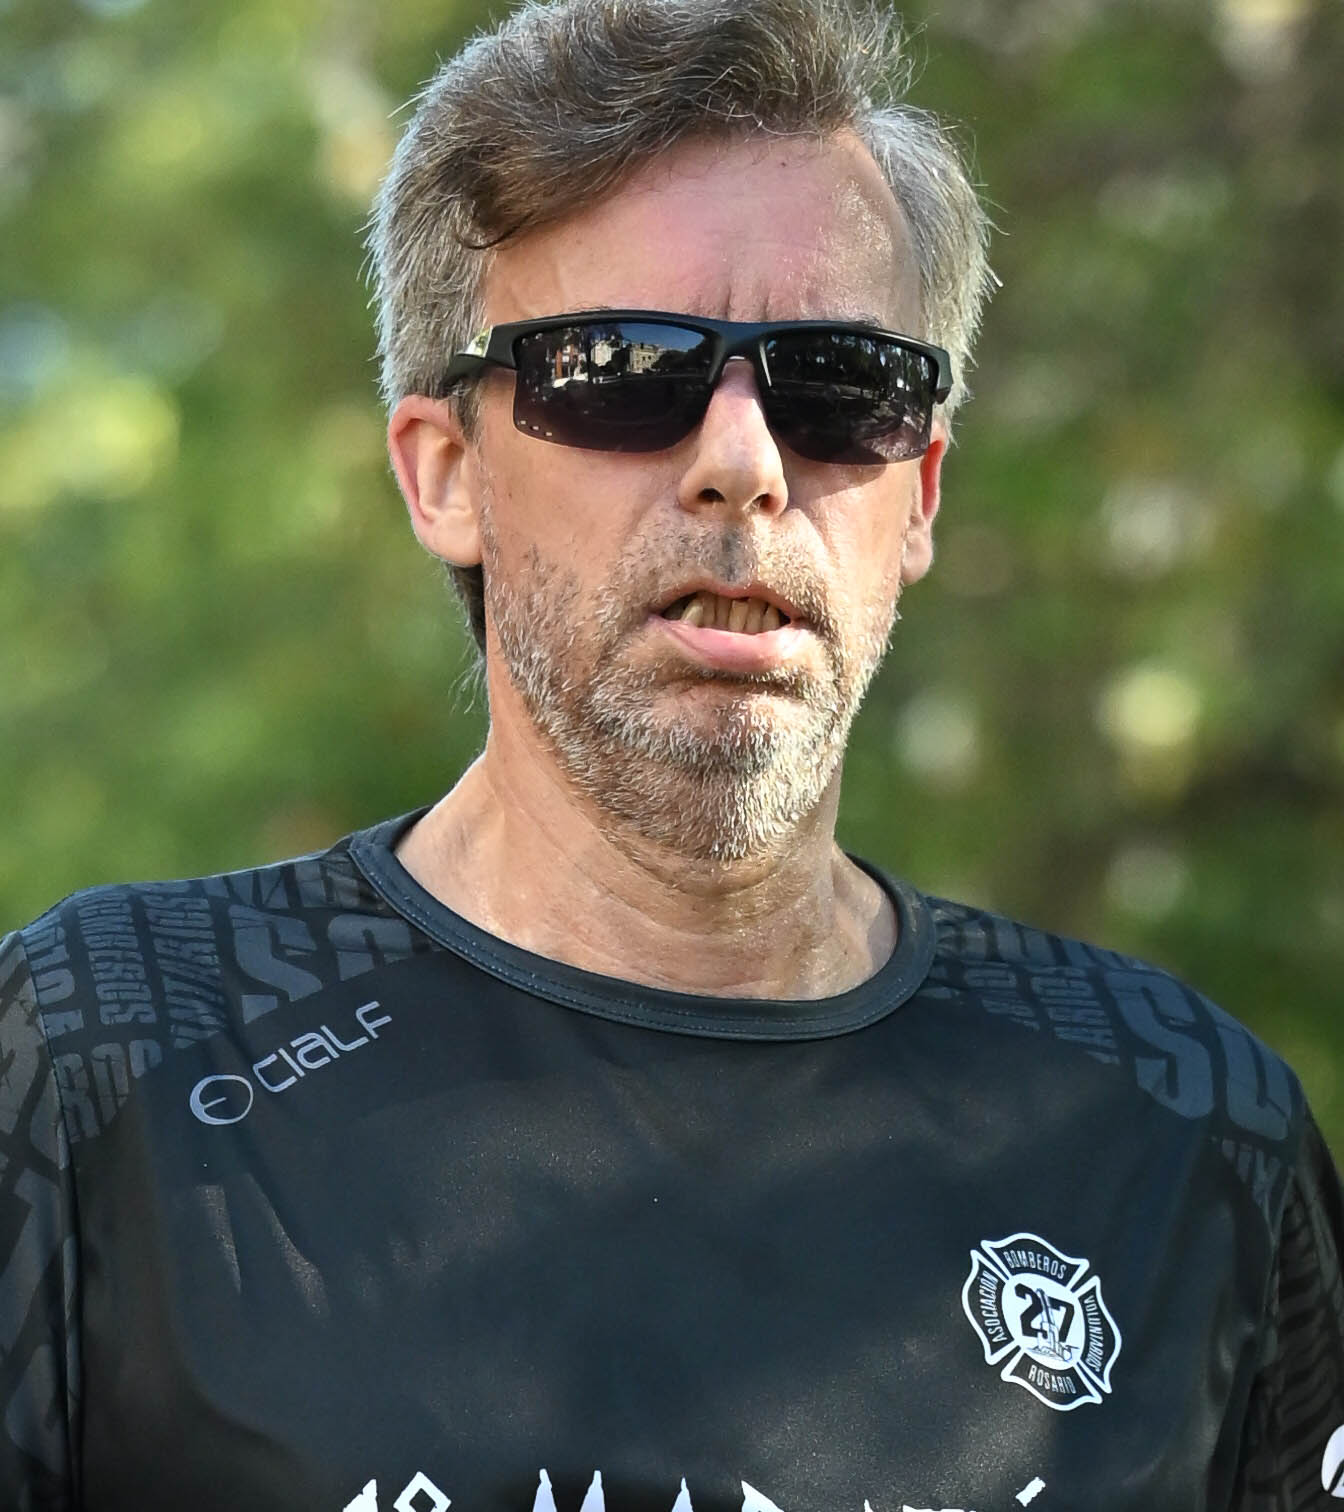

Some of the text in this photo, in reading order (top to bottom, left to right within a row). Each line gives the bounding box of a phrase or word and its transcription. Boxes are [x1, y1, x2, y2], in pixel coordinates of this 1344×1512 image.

[1002, 1249, 1067, 1280] BOMBEROS
[978, 1270, 1008, 1343] ASOCIACIÓN
[1014, 1282, 1075, 1343] 27
[1082, 1294, 1105, 1373] VOLUNTARIOS
[1028, 1364, 1077, 1394] ROSARIO
